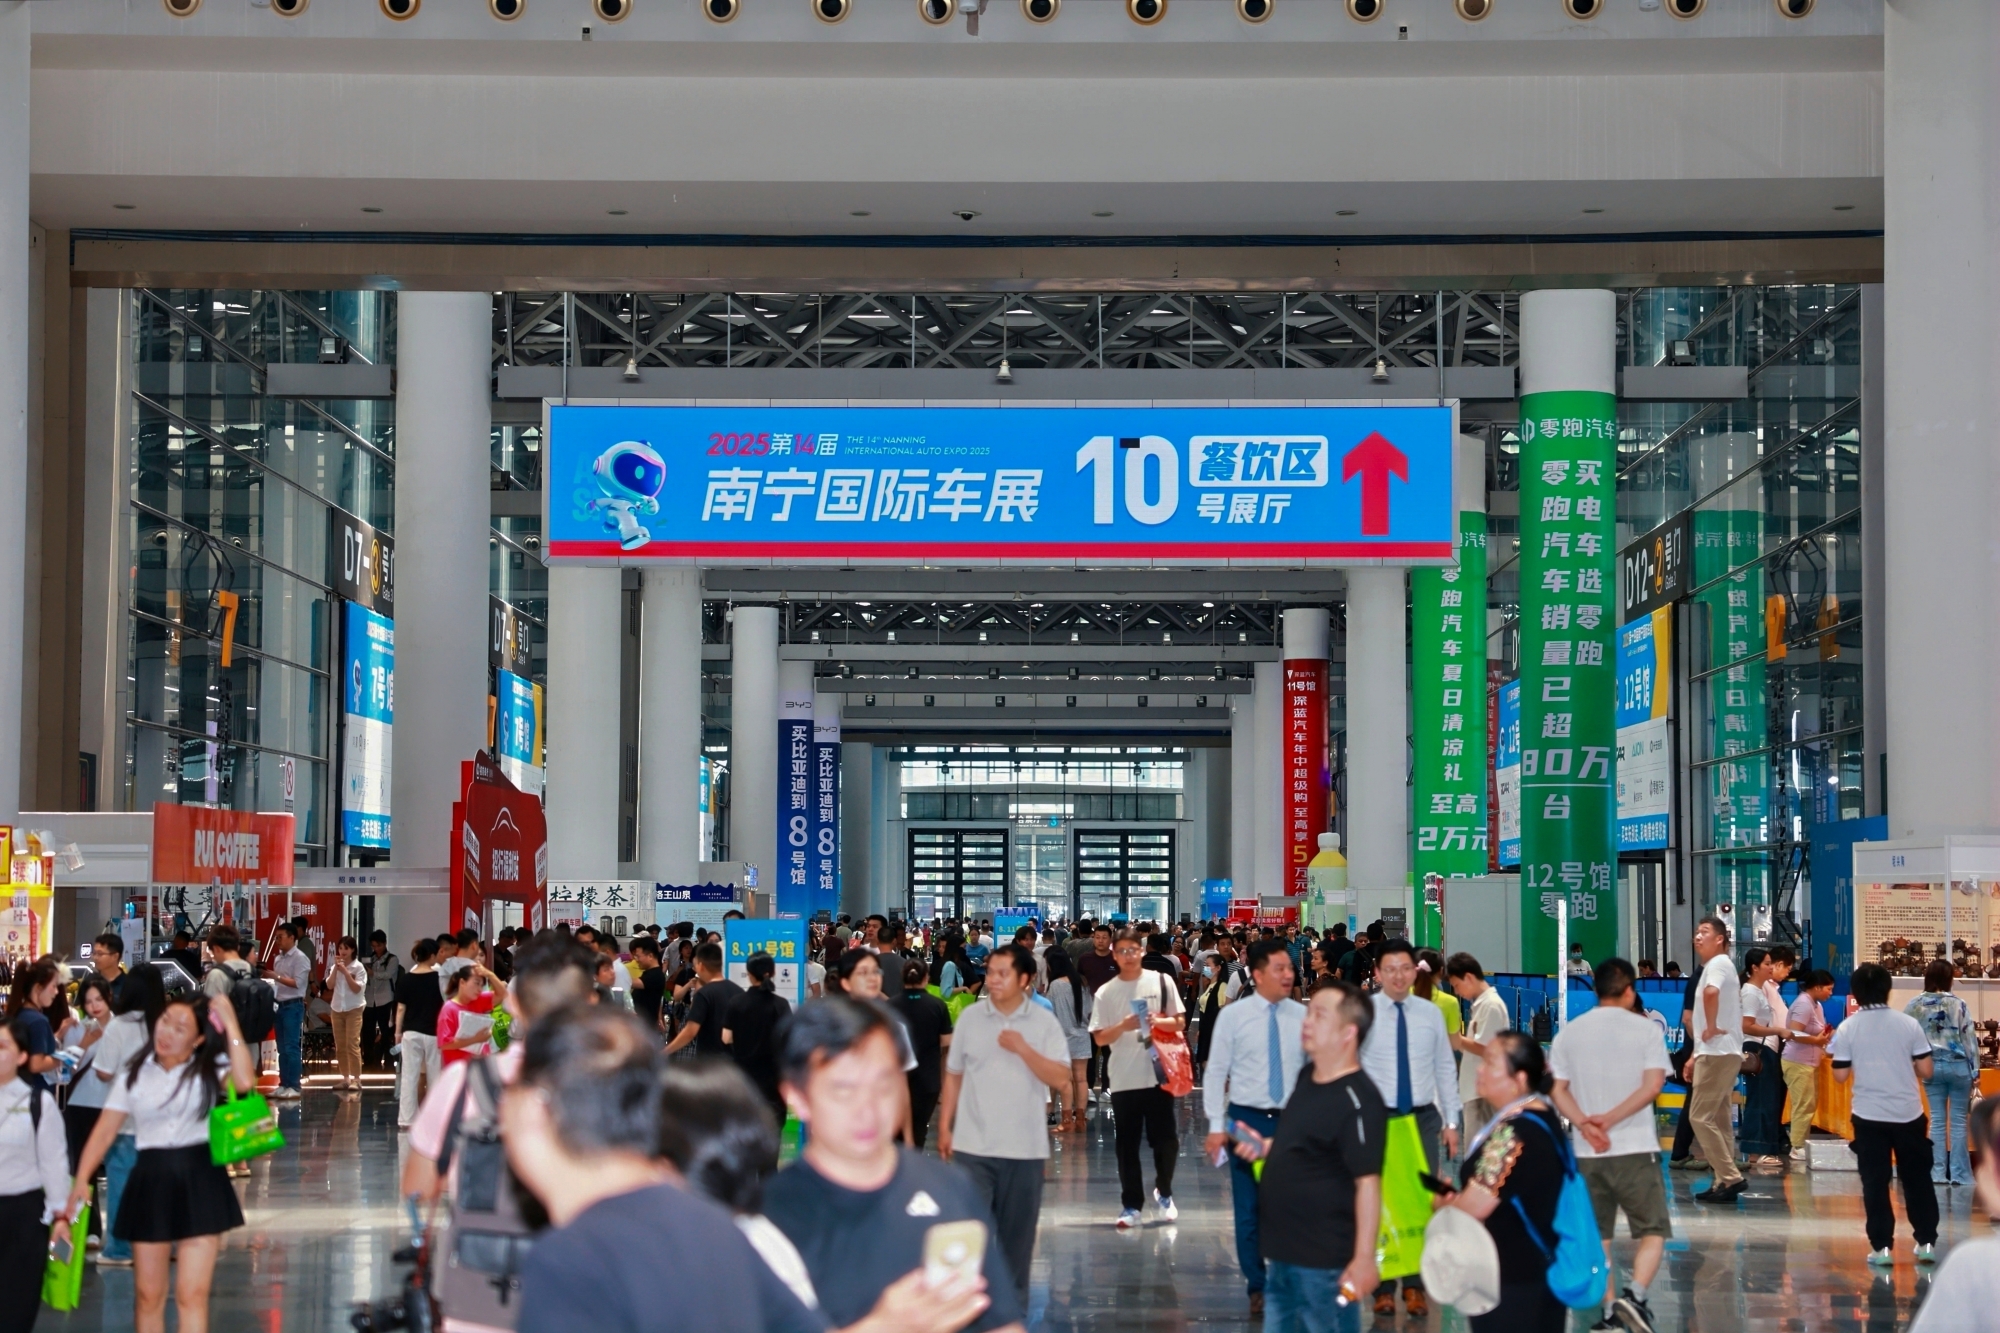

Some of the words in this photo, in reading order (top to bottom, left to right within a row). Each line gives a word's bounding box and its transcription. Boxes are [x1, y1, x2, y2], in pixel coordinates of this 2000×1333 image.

[847, 436, 864, 444] THE
[883, 436, 926, 444] NANNING
[1540, 418, 1616, 439] 零跑汽车
[706, 432, 839, 456] 2025第14届
[845, 447, 914, 455] INTERNATIONAL
[916, 447, 942, 455] AUTO
[944, 447, 968, 455] EXPO
[970, 447, 990, 455] 2025
[1199, 441, 1322, 481] 餐饮区
[701, 466, 1044, 522] 南宁国际车展
[1076, 435, 1179, 526] 10
[1197, 494, 1291, 524] 号展厅
[1575, 460, 1603, 666] 买电车选零跑
[1540, 460, 1572, 739] 零跑汽车销量已超
[218, 590, 239, 667] 7
[1287, 681, 1316, 691] 11号馆
[1441, 565, 1463, 782] 零跑汽车夏日清凉礼
[1625, 663, 1650, 711] 12号馆
[785, 701, 812, 709] BYD
[1522, 746, 1611, 779] 80万
[788, 725, 808, 885] 买比亚迪到8号馆
[817, 747, 835, 890] 买比亚迪到8号馆
[1429, 793, 1477, 814] 至高
[1543, 794, 1571, 819] 台
[217, 831, 260, 870] COFFEE
[1419, 826, 1487, 851] 2万元
[338, 876, 377, 884] 招商银行
[1526, 861, 1611, 891] 12号馆
[549, 884, 629, 908] 柠檬茶
[1540, 891, 1598, 921] 零跑
